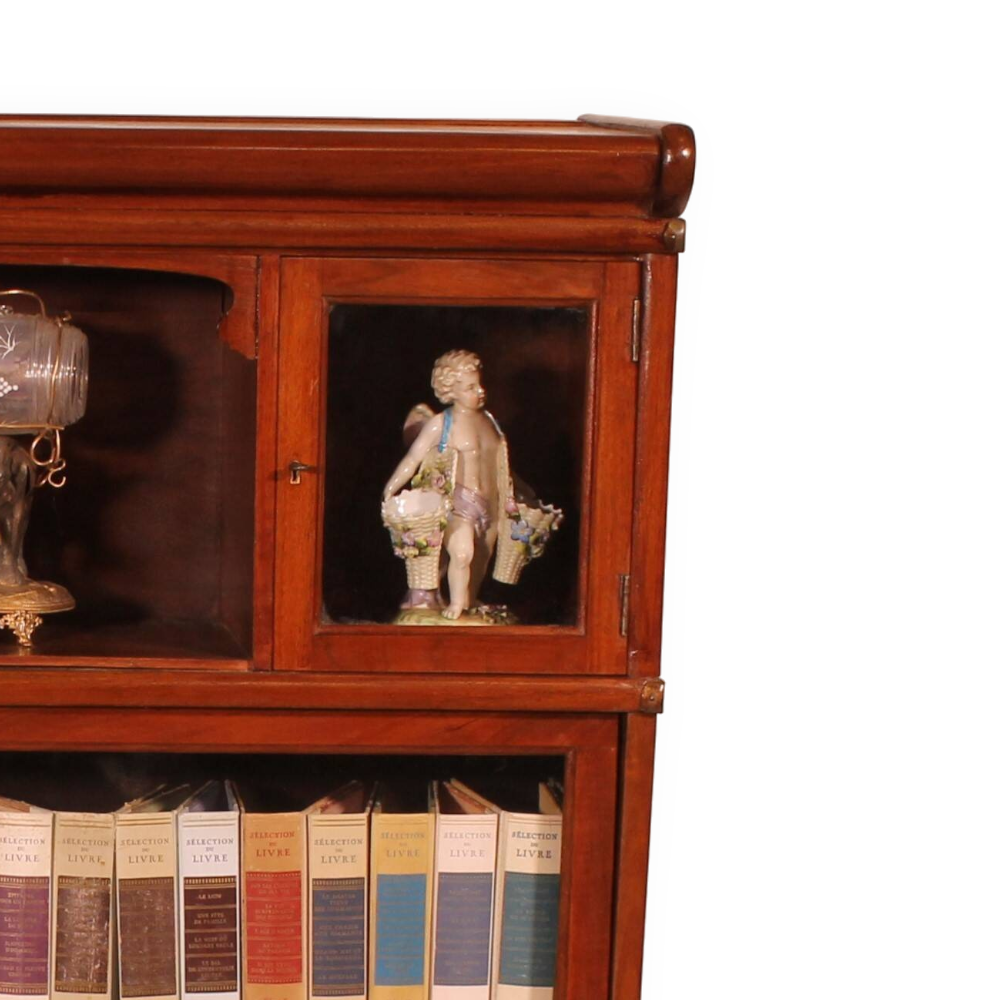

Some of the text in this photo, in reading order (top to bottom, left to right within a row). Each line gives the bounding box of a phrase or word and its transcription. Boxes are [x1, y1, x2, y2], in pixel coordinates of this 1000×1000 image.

[256, 848, 291, 858] LIVRE
[450, 849, 485, 858] LIVRE
[516, 849, 552, 859] LIVRE
[4, 854, 40, 863] LIVRE
[68, 855, 103, 864] LIVRE
[128, 854, 164, 864] LIVRE
[193, 854, 229, 863] LIVRE
[321, 855, 357, 864] LIVRE
